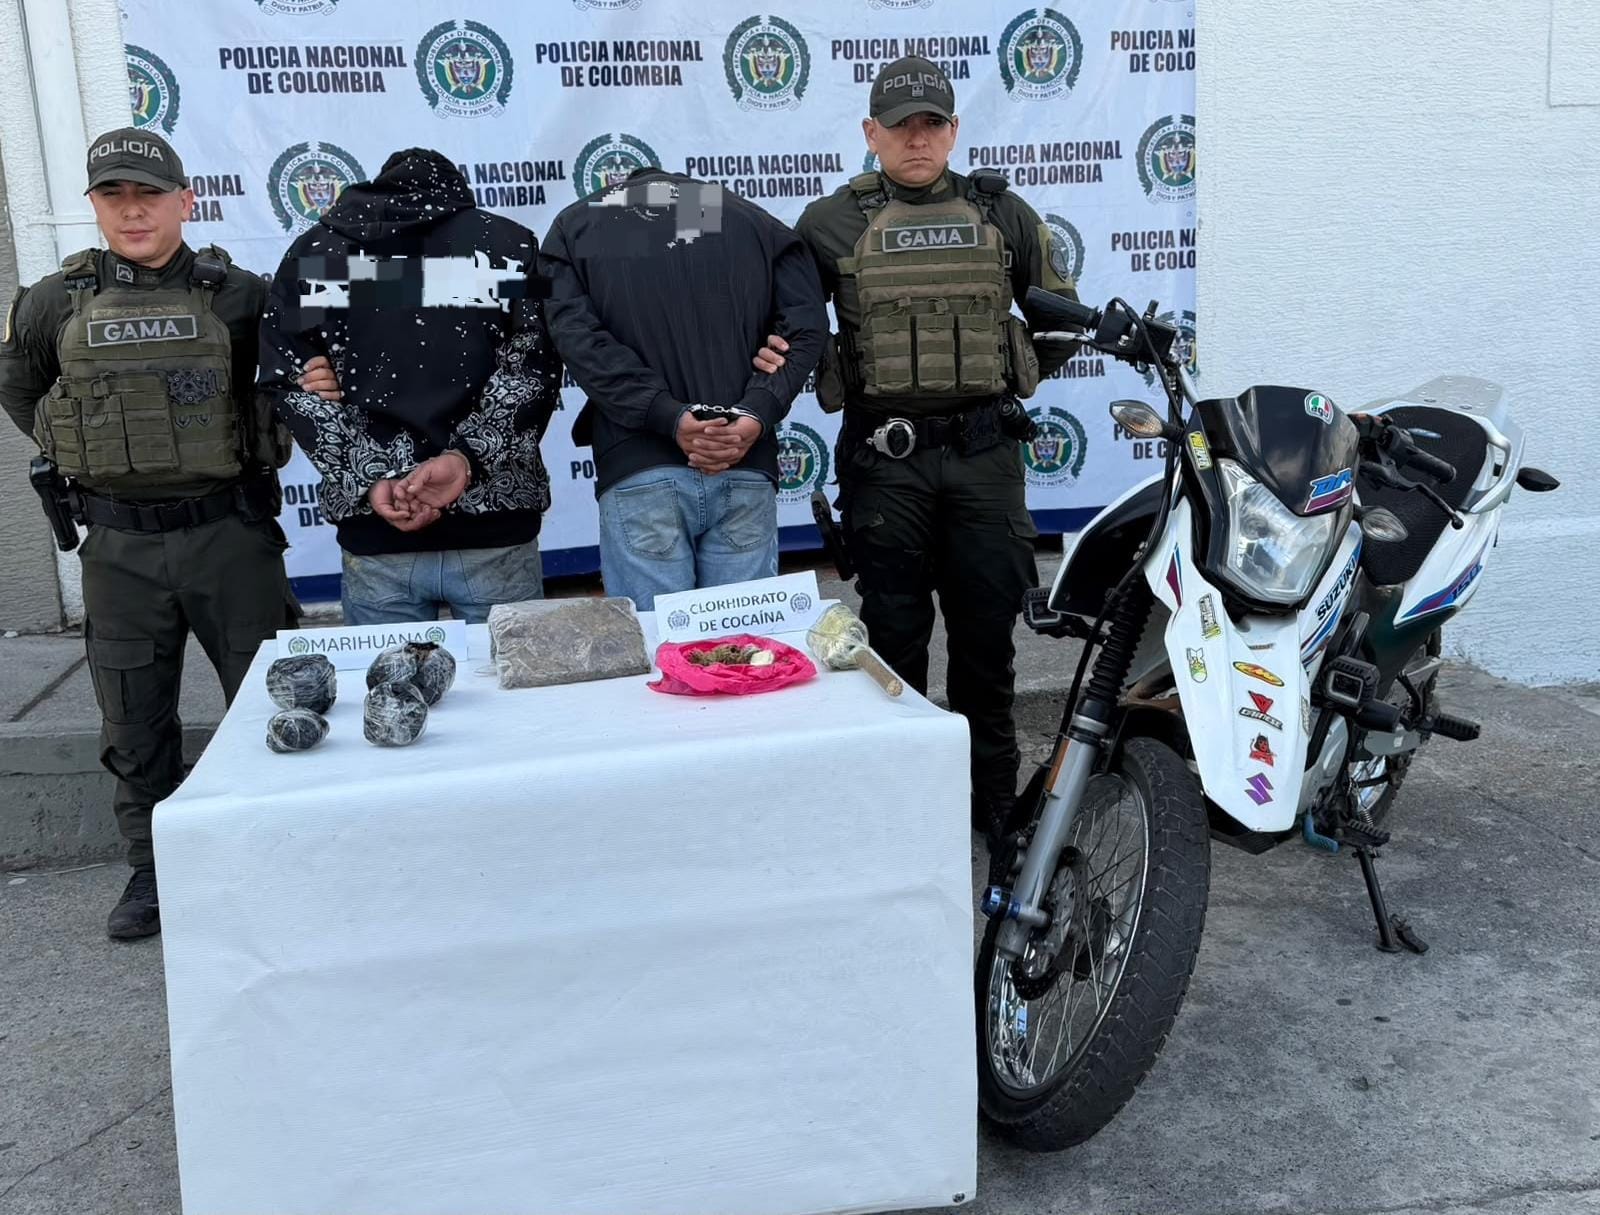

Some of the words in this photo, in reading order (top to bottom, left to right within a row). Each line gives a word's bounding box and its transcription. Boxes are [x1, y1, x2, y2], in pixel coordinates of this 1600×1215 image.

[831, 38, 899, 60] POLICIA
[904, 36, 991, 57] NACIONAL
[1110, 30, 1174, 51] POLICIA
[218, 46, 301, 69] POLICIA
[305, 46, 407, 68] NACIONAL
[535, 40, 609, 64] POLICIA
[613, 40, 703, 62] NACIONAL
[1130, 53, 1150, 73] DE
[247, 72, 274, 94] DE
[278, 71, 386, 94] COLOMBIA
[561, 66, 584, 87] DE
[589, 65, 683, 87] COLOMBIA
[854, 62, 874, 83] DE
[883, 72, 948, 94] POLICÍA
[90, 140, 164, 163] POLICÍA
[968, 144, 1036, 166] POLICIA
[1040, 140, 1123, 163] NACIONAL
[474, 161, 566, 184] NACIONAL
[685, 155, 754, 177] POLICIA
[758, 153, 844, 175] NACIONAL
[1015, 164, 1103, 186] COLOMBIA
[476, 185, 546, 208] LOMBIA
[734, 177, 824, 198] COLOMBIA
[897, 228, 963, 247] GAMA
[1111, 230, 1175, 251] POLICIA
[1131, 252, 1150, 272] DE
[104, 320, 180, 341] GAMA
[1133, 442, 1153, 460] DE
[298, 507, 324, 527] DE
[1317, 558, 1356, 621] SUZUKI
[690, 591, 787, 615] CLORHIDRATO
[700, 620, 718, 632] DE
[721, 610, 785, 629] COCAÍNA
